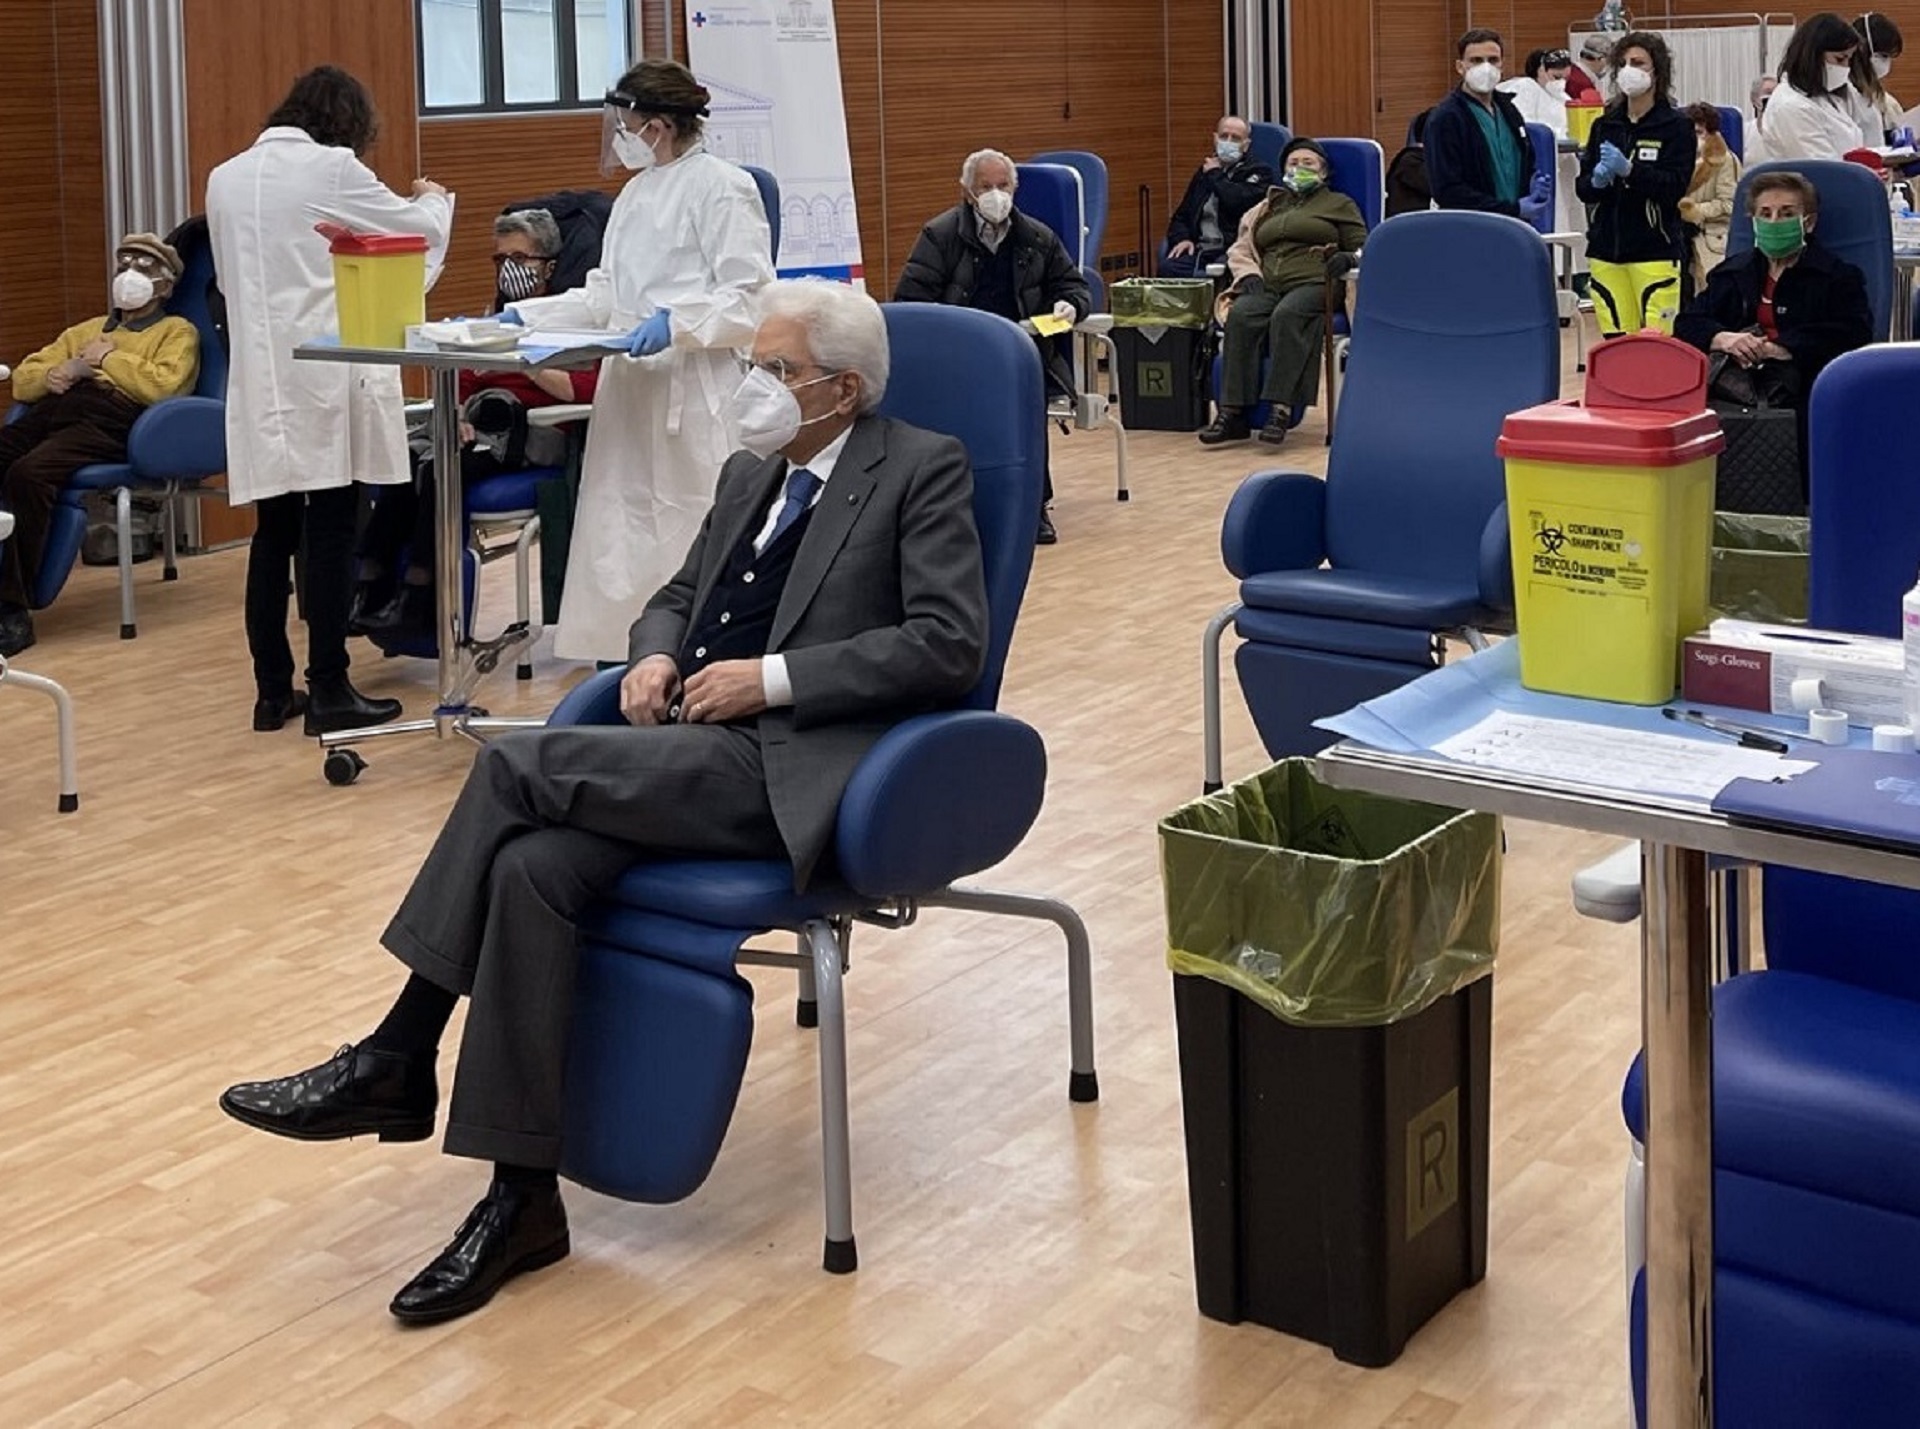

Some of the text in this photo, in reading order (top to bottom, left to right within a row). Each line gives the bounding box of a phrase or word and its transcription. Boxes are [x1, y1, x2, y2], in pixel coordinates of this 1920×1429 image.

[1146, 368, 1164, 391] R
[1568, 523, 1624, 540] CONTAMINATED
[1571, 537, 1621, 553] SHARPS ONLY
[1533, 555, 1579, 573] PERICOLO
[1420, 1121, 1446, 1210] R
